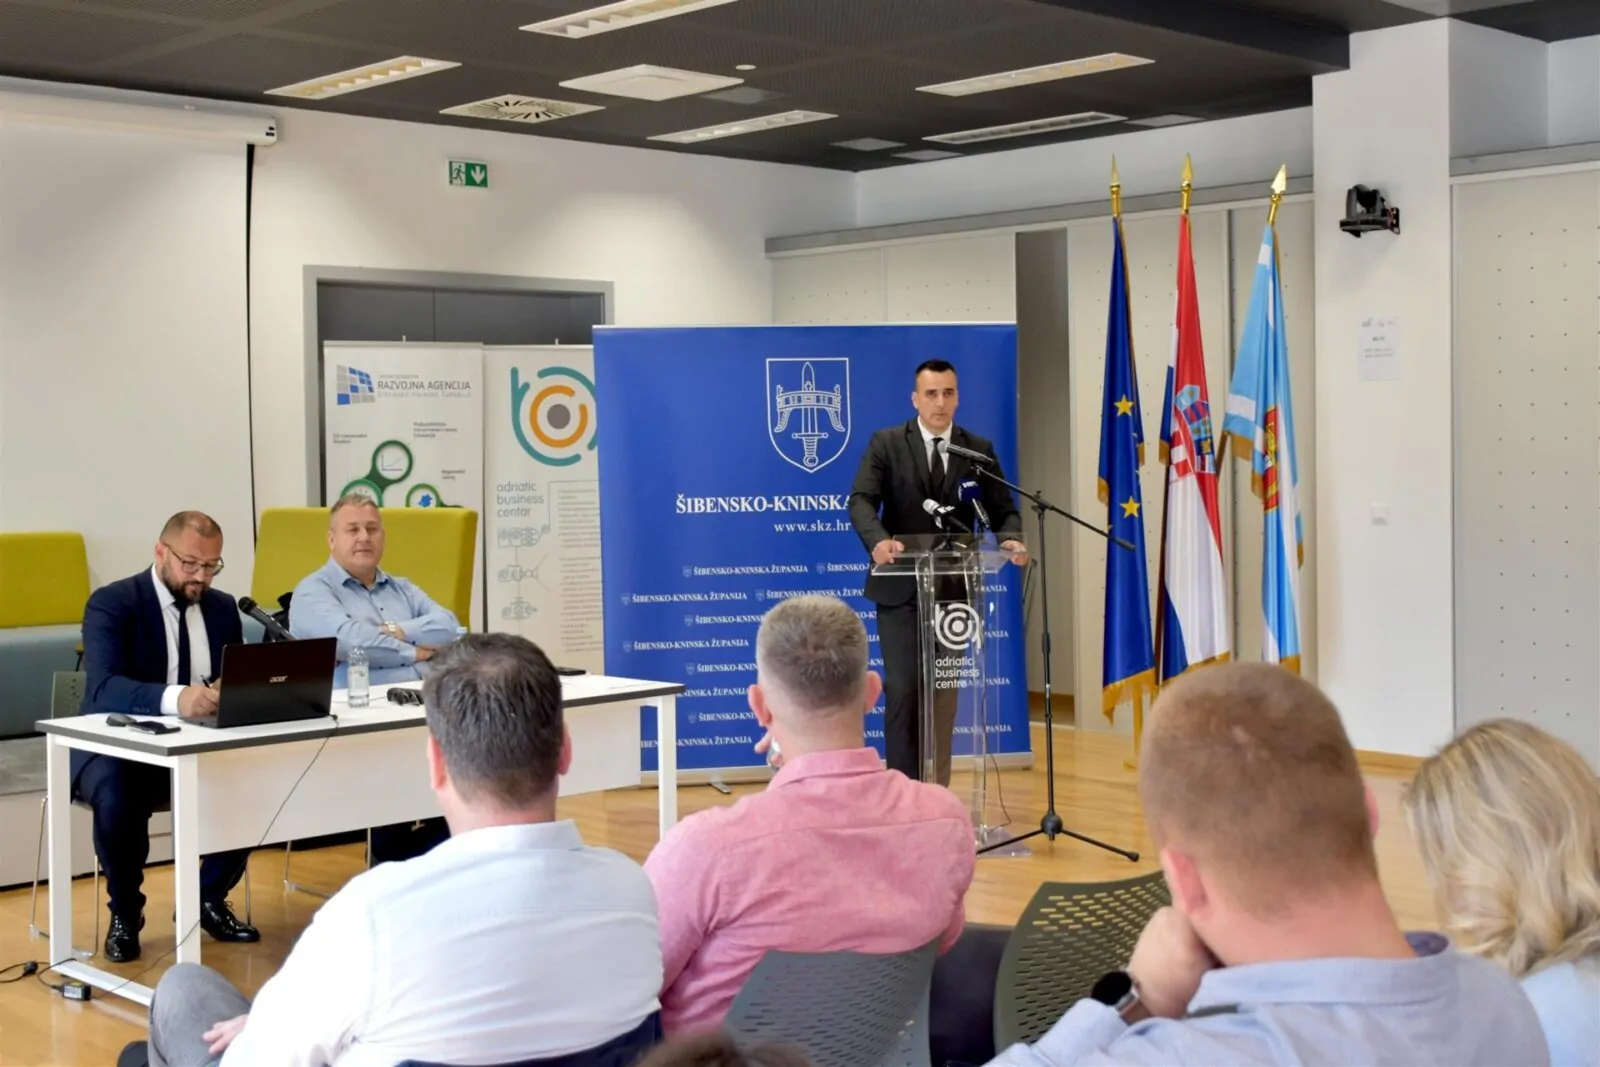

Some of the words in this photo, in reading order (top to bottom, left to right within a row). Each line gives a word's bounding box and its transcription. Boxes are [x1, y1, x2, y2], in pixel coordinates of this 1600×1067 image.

[377, 380, 425, 391] RAZVOJNA
[427, 380, 472, 391] AGENCIJA
[496, 480, 537, 492] adriatic
[496, 494, 544, 505] business
[497, 507, 531, 518] centar
[774, 519, 852, 532] www.skz.hr
[693, 565, 770, 577] ŠIBENSKO-KNINSKA
[771, 564, 808, 574] ŽUPANIJA
[827, 562, 869, 572] ŠIBENSKO-
[632, 592, 708, 603] ŠIBENSKO-KNINSKA
[709, 591, 747, 601] ŽUPANIJA
[633, 640, 710, 651] ŠIBENSKO-KNINSKA
[711, 638, 749, 648] ŽUPANIJA
[935, 655, 975, 667] adriatic
[935, 667, 980, 678] business
[269, 675, 288, 683] acer
[935, 679, 968, 689] centre
